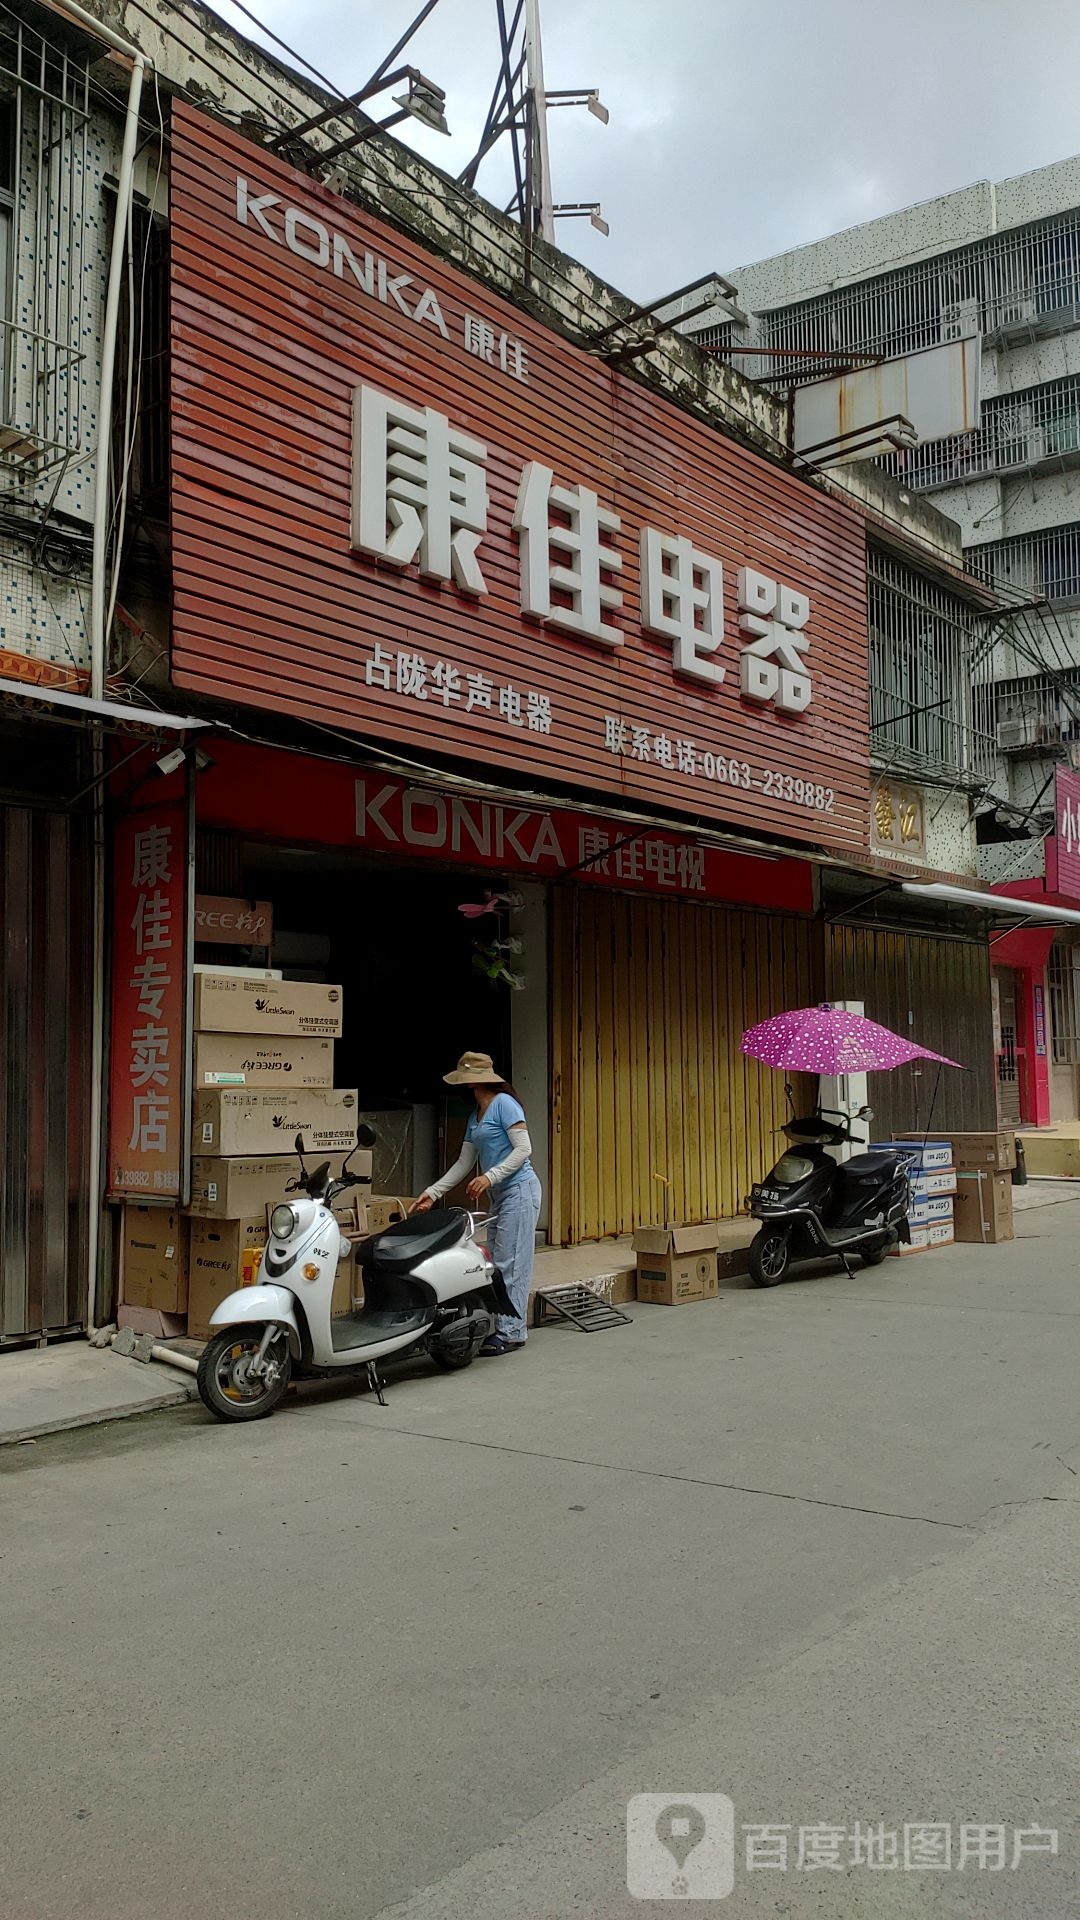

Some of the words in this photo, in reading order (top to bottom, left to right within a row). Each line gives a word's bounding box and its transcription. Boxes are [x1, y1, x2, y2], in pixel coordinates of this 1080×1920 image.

[236, 176, 450, 340] KONKA
[464, 312, 529, 385] 康佳
[349, 384, 812, 713] 康佳电器
[365, 642, 553, 734] 占陇华声电器
[355, 779, 566, 867] KONKA
[579, 826, 707, 891] 康佳电视
[128, 824, 173, 1153] 康佳专卖店
[265, 1006, 295, 1016] LittleSwan
[282, 1121, 312, 1131] LittleSwan
